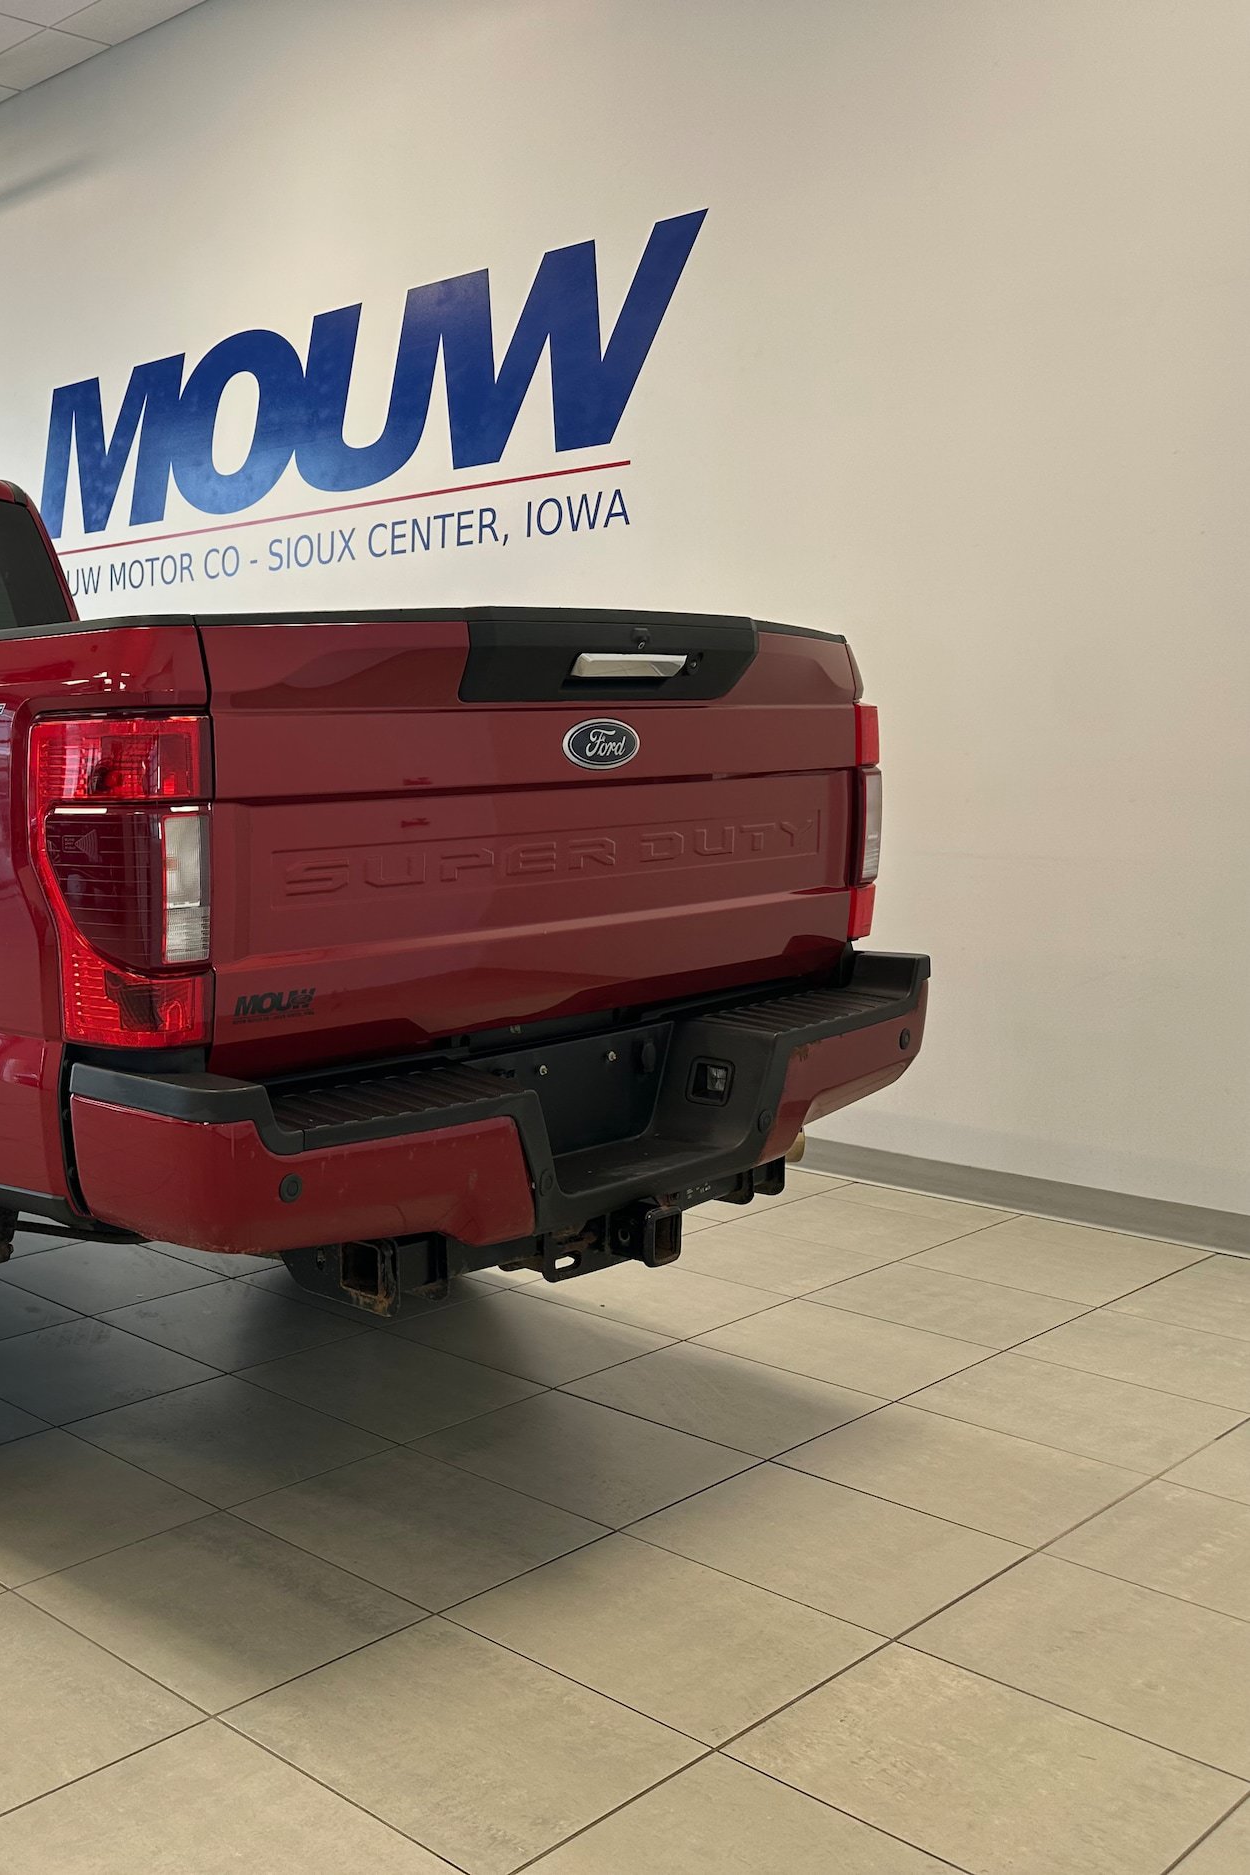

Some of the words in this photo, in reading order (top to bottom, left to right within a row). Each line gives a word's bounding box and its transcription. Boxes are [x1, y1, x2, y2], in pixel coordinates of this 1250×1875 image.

[40, 209, 708, 539] MOUW
[66, 566, 101, 596] UW
[110, 552, 194, 592] MOTOR
[204, 546, 240, 580] CO
[268, 527, 356, 572] SIOUX
[368, 507, 509, 558] CENTER,
[526, 489, 630, 538] IOWA
[585, 729, 627, 757] Ford
[285, 835, 617, 896] SUPER
[640, 818, 815, 863] DUTY
